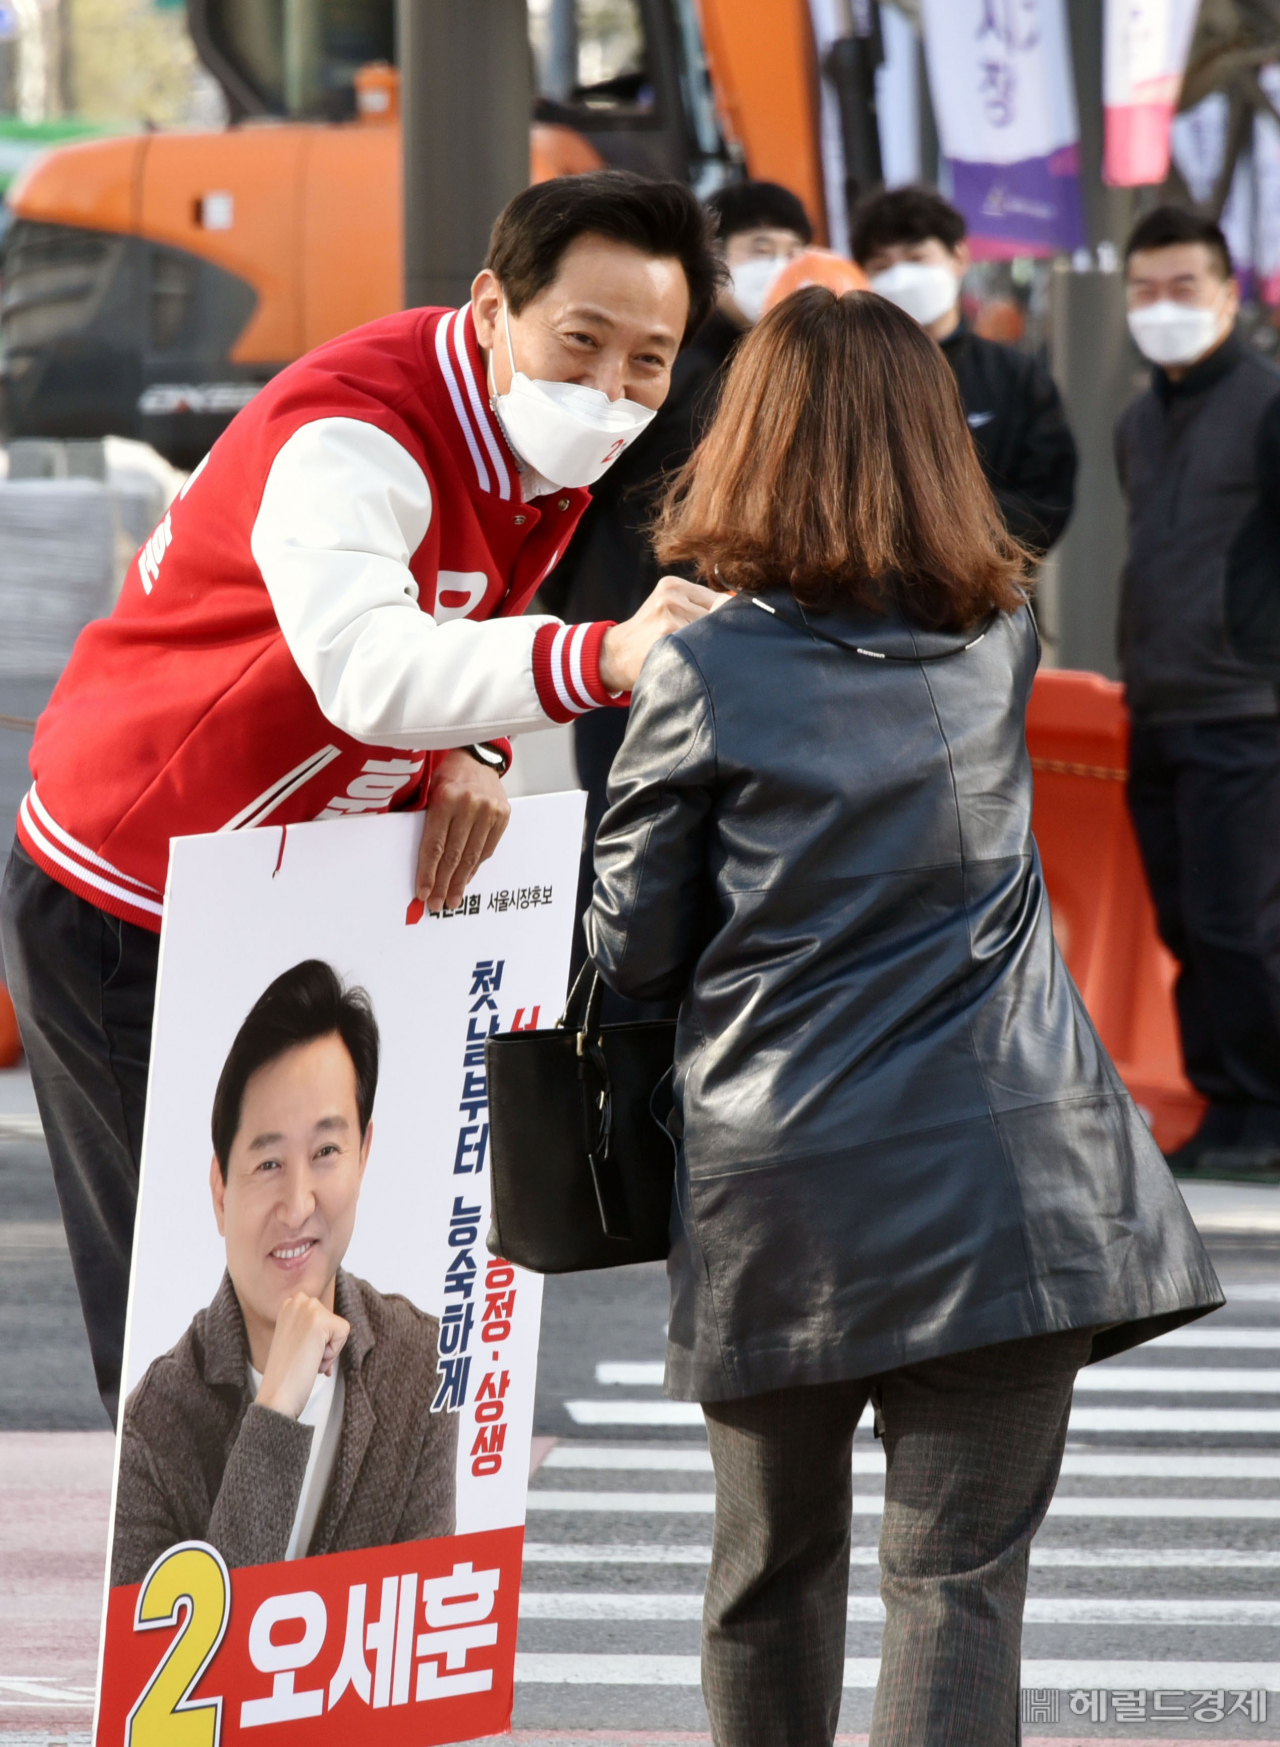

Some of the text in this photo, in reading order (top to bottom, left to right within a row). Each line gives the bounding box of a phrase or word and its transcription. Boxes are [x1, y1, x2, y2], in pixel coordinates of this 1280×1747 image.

[487, 885, 553, 913] 서울시장후보
[433, 1195, 482, 1410] 능숙하게
[125, 1540, 501, 1747] 2 오세훈
